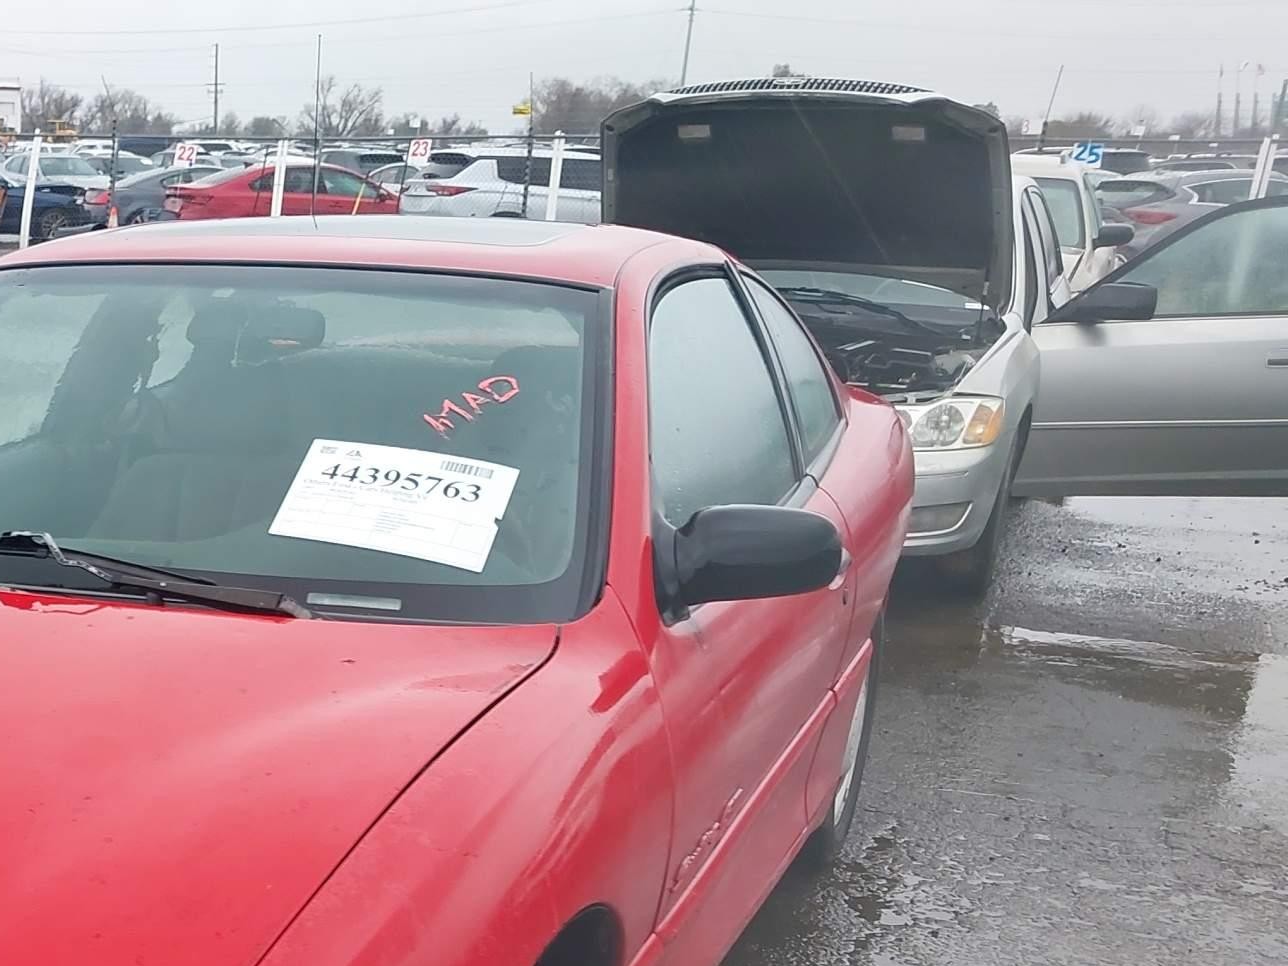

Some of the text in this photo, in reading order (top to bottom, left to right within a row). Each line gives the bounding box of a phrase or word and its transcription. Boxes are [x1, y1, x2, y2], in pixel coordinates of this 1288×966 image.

[177, 145, 195, 162] 22
[412, 140, 429, 157] 23
[1074, 143, 1102, 164] 25
[321, 463, 482, 503] 44395763
